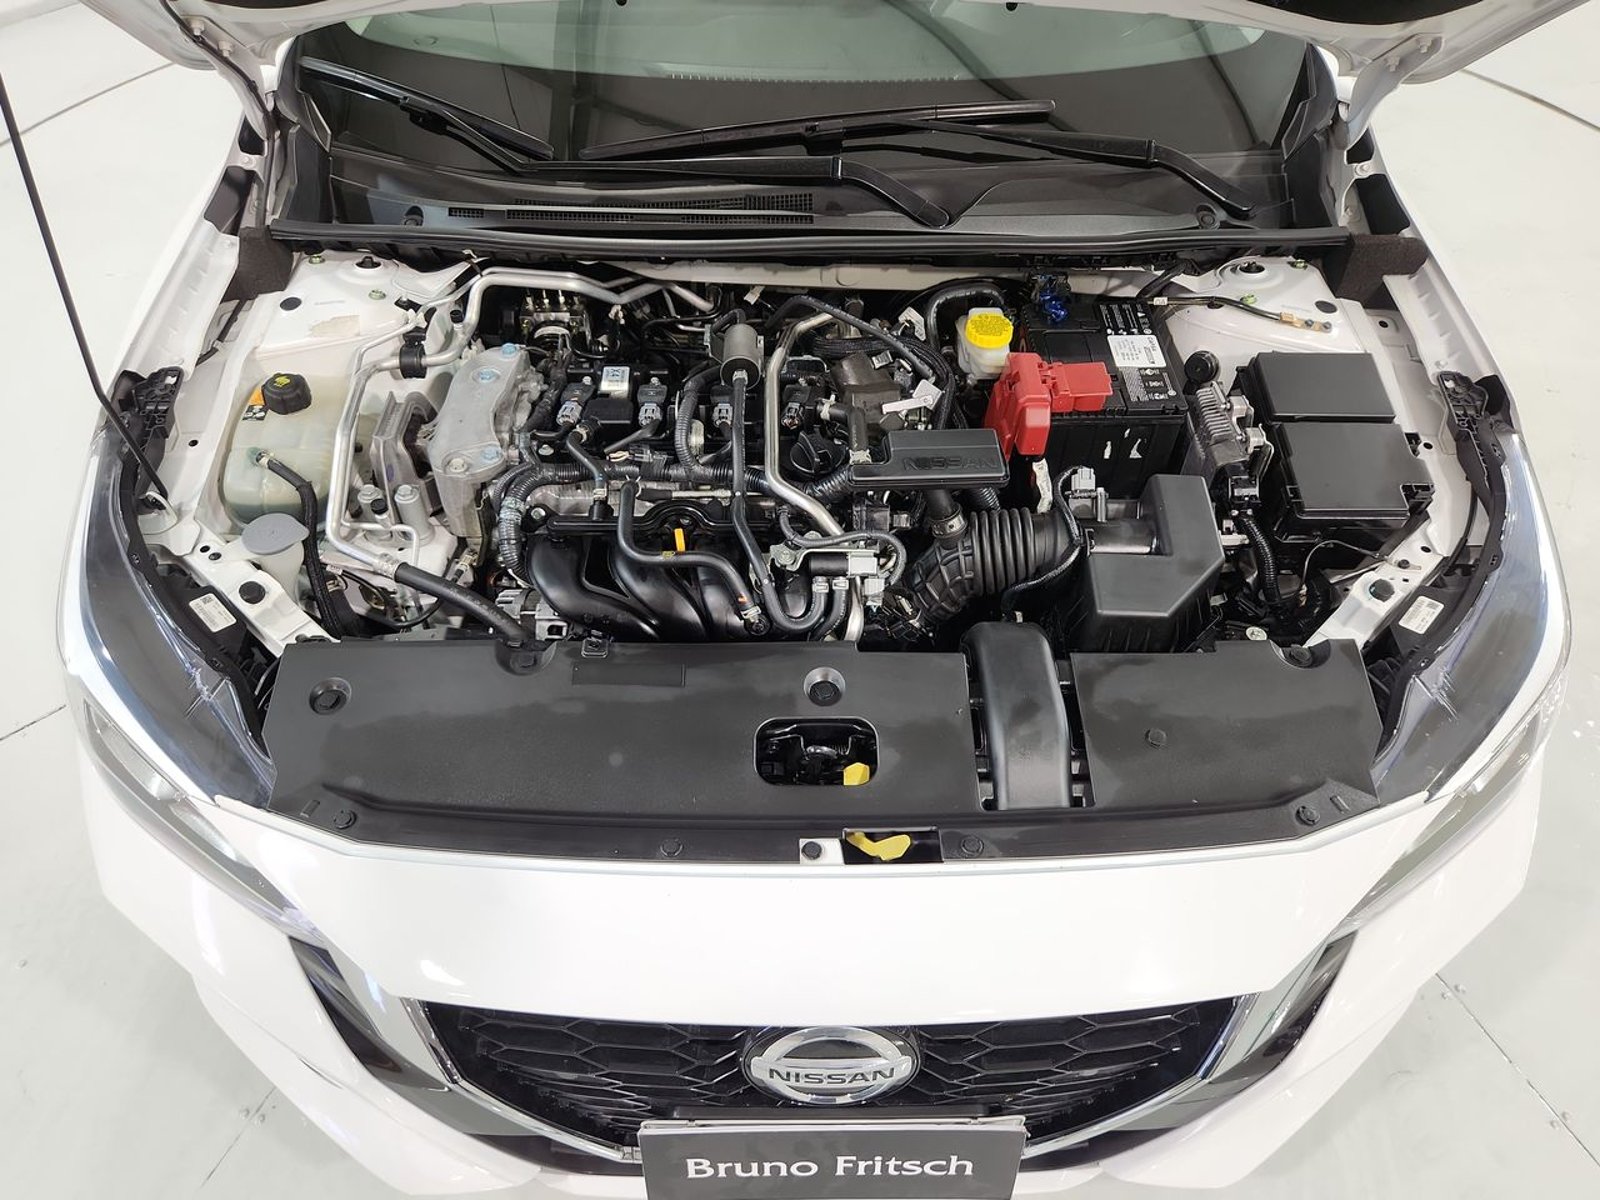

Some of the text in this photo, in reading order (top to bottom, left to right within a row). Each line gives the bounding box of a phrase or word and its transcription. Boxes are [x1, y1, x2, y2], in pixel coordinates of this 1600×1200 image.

[769, 1067, 895, 1085] NISSAN
[685, 1155, 974, 1179] Bruno Fritsch
